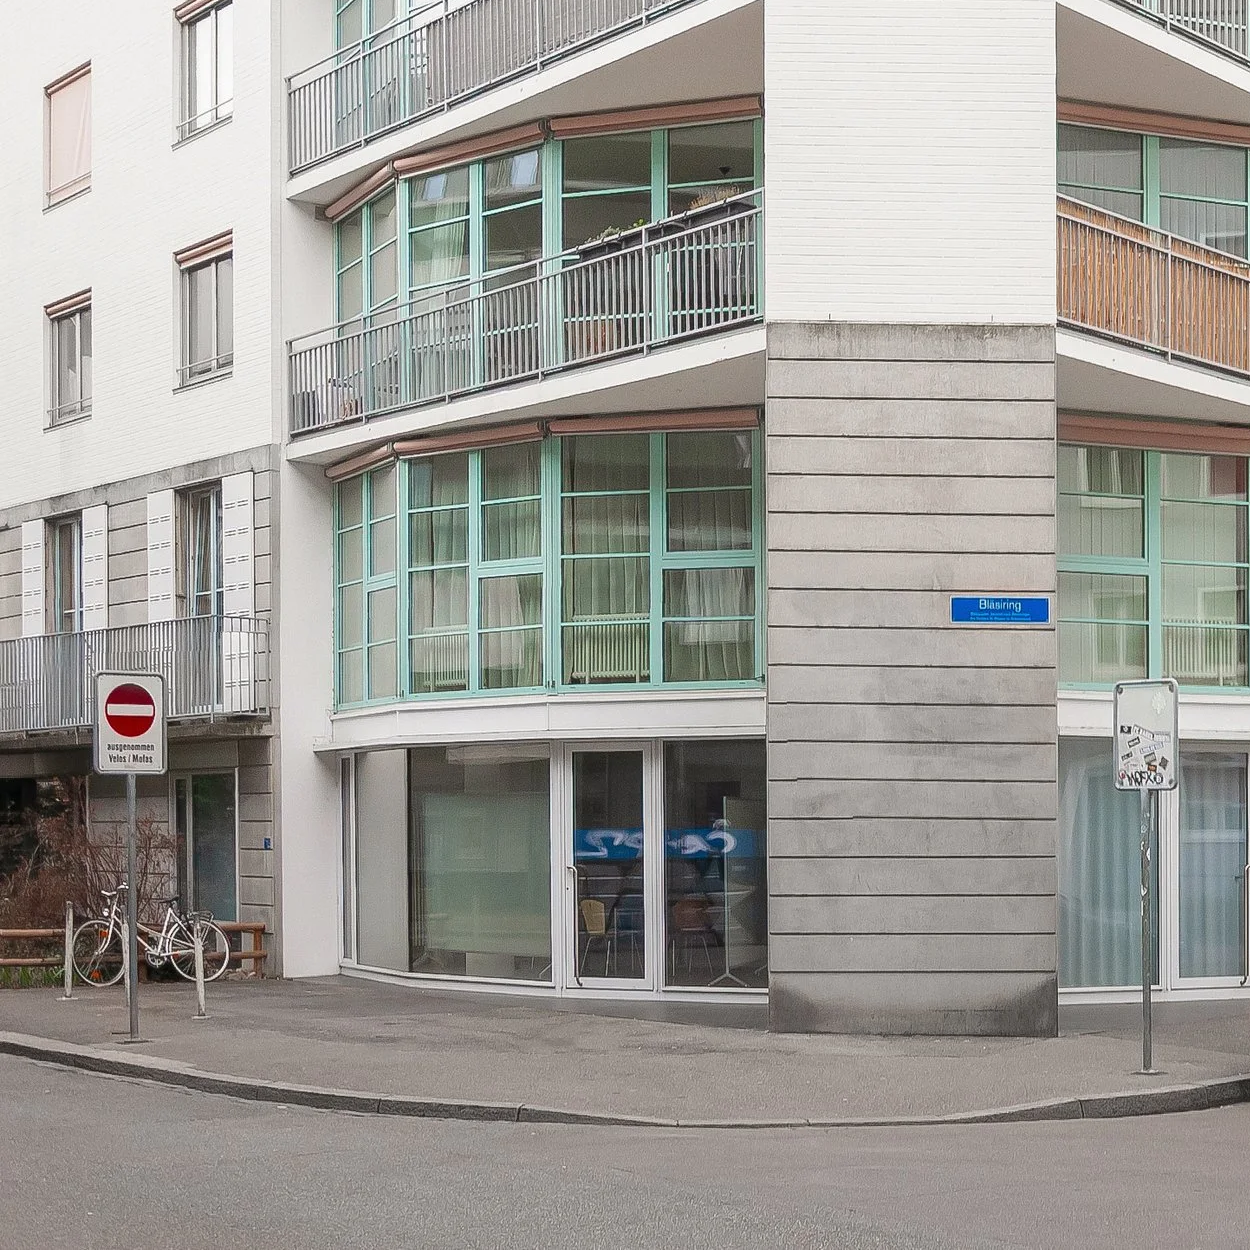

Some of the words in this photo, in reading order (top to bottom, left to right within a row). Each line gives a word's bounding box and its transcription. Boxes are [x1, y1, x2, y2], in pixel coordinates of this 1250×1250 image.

[979, 598, 1022, 613] Bläsiring
[107, 743, 155, 752] ausgenommen
[108, 753, 127, 763] Velos
